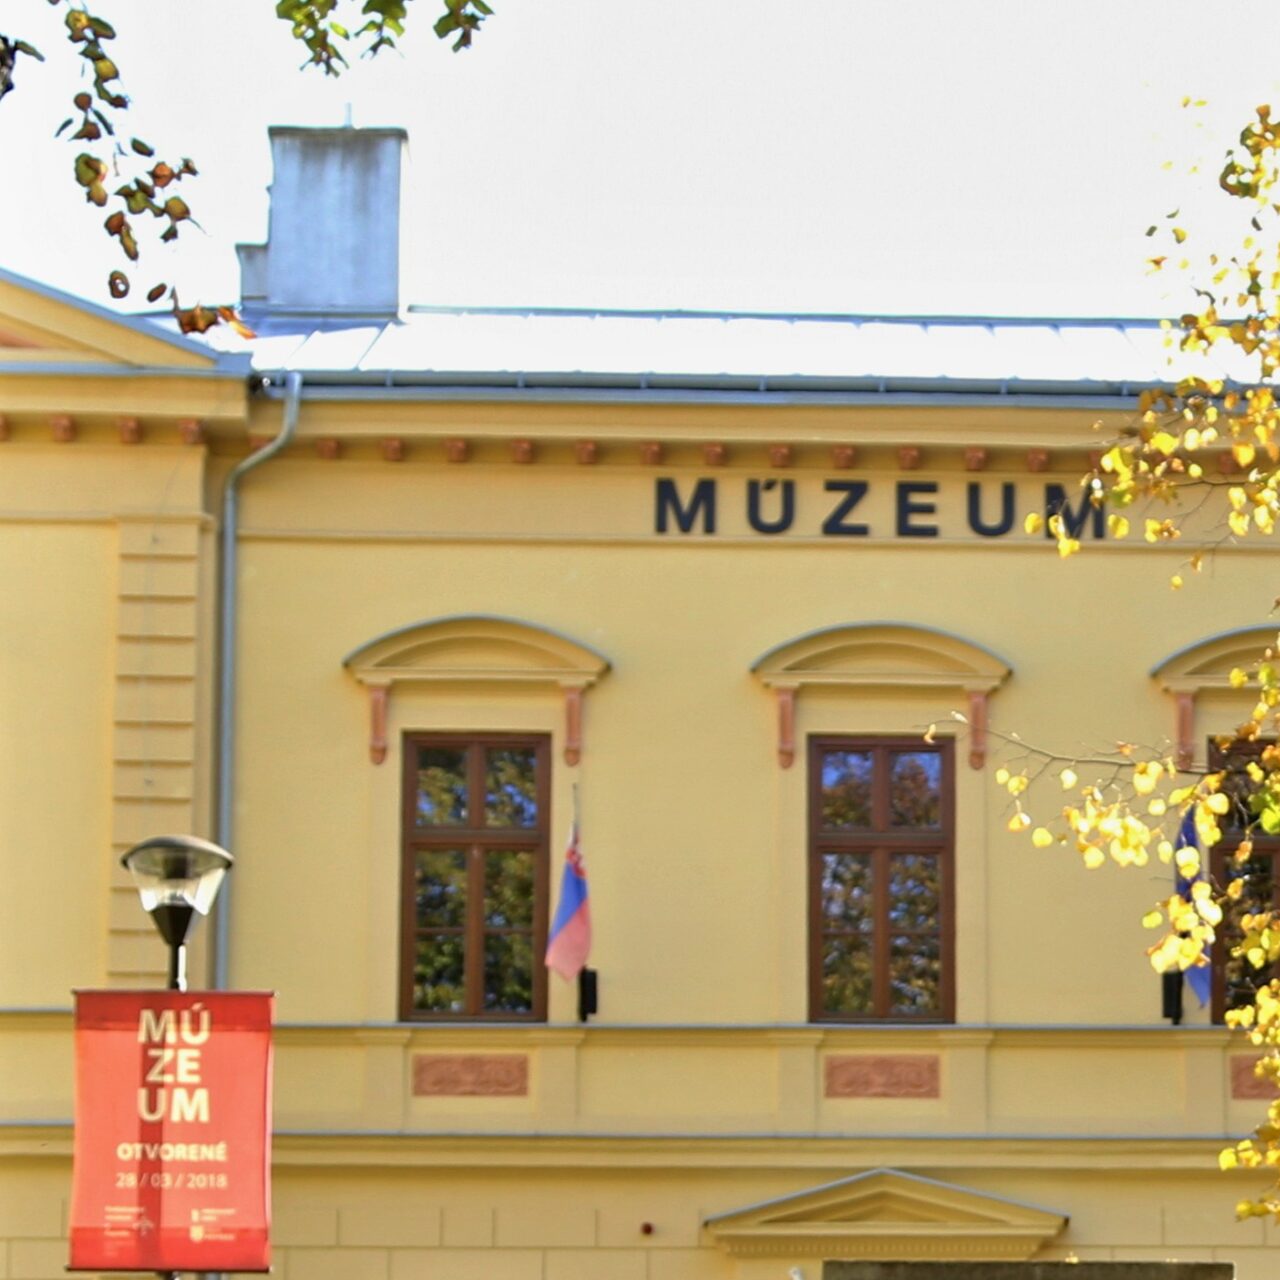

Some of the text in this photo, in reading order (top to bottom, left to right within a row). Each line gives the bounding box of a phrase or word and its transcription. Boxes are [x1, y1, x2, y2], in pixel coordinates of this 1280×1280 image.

[654, 477, 1105, 539] MÚZEUM
[137, 1002, 212, 1045] MÚ
[146, 1048, 201, 1083] ZE
[137, 1087, 210, 1123] UM
[116, 1140, 227, 1161] OTVORENÉ
